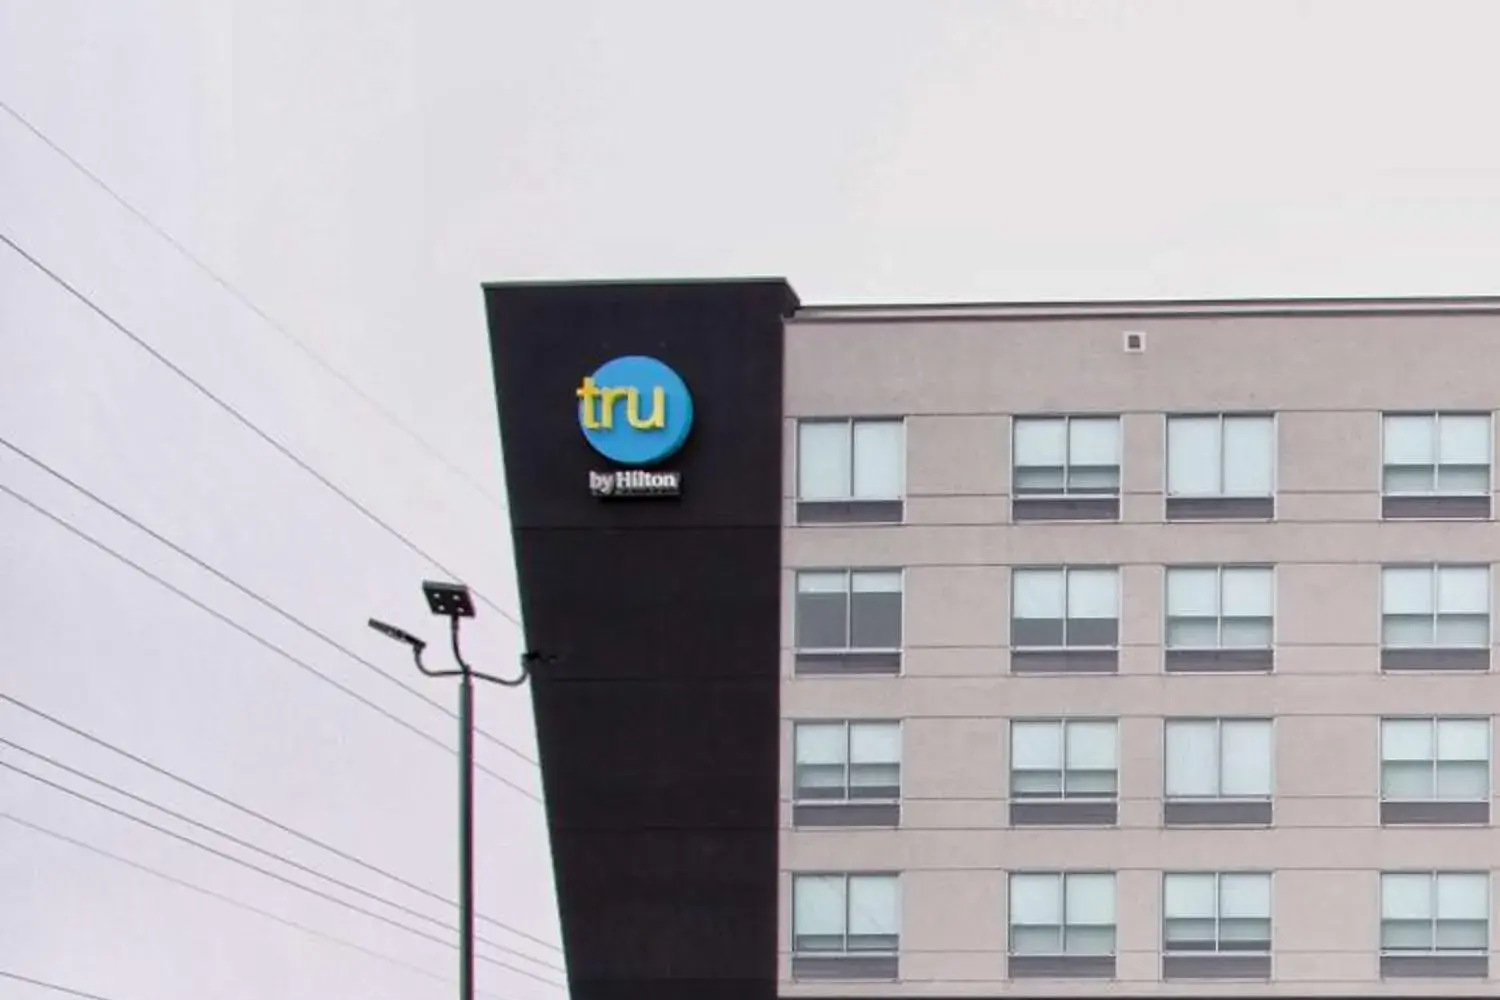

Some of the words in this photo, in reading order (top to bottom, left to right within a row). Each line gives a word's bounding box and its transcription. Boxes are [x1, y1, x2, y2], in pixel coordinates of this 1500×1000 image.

[576, 376, 666, 430] tru
[589, 470, 614, 495] by
[615, 470, 679, 491] Hilton
